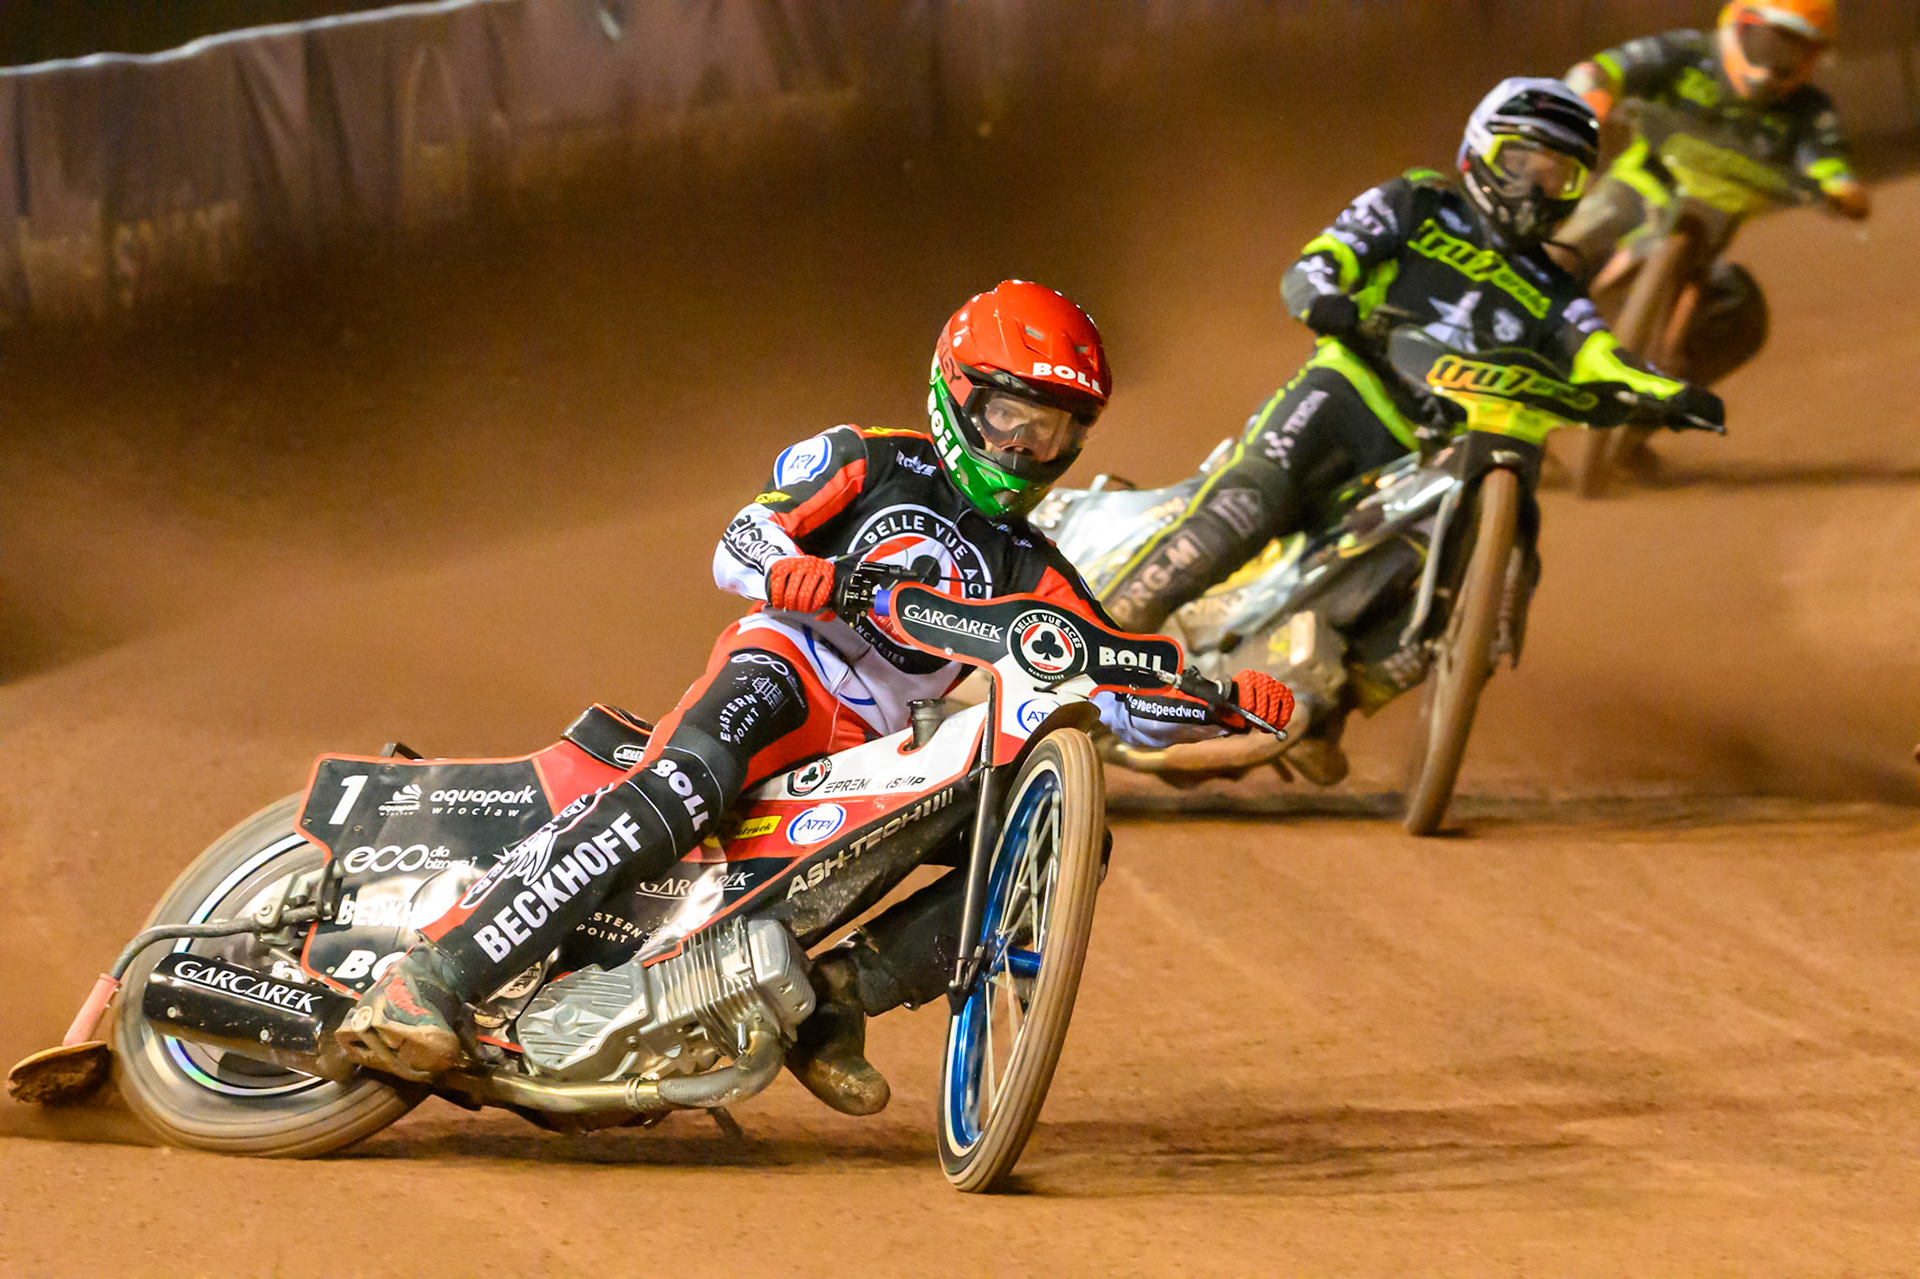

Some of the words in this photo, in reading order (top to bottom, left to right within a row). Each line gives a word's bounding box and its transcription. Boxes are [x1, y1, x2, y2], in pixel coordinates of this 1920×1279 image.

[1032, 361, 1104, 396] BOLL
[864, 514, 925, 544] BELLE
[935, 522, 968, 560] VUE
[963, 568, 983, 600] AC
[903, 604, 1004, 641] GARCAREK
[1013, 614, 1039, 635] BELLE
[1041, 613, 1062, 627] VUE
[1063, 626, 1082, 649] ACES
[719, 694, 758, 743] EASTERN
[733, 707, 759, 744] POINT
[1026, 711, 1049, 723] AT
[328, 775, 369, 825] 1
[430, 785, 537, 807] aquapark
[650, 759, 709, 832] BOLL
[798, 819, 834, 832] ATPI
[430, 845, 450, 857] dla
[473, 812, 642, 964] BECKHOFF
[639, 872, 754, 897] GARREK
[335, 899, 424, 931] BECKH
[592, 912, 643, 939] STERN
[576, 923, 629, 944] POINT
[332, 950, 407, 982] BO
[174, 960, 323, 1013] GARCAREK
